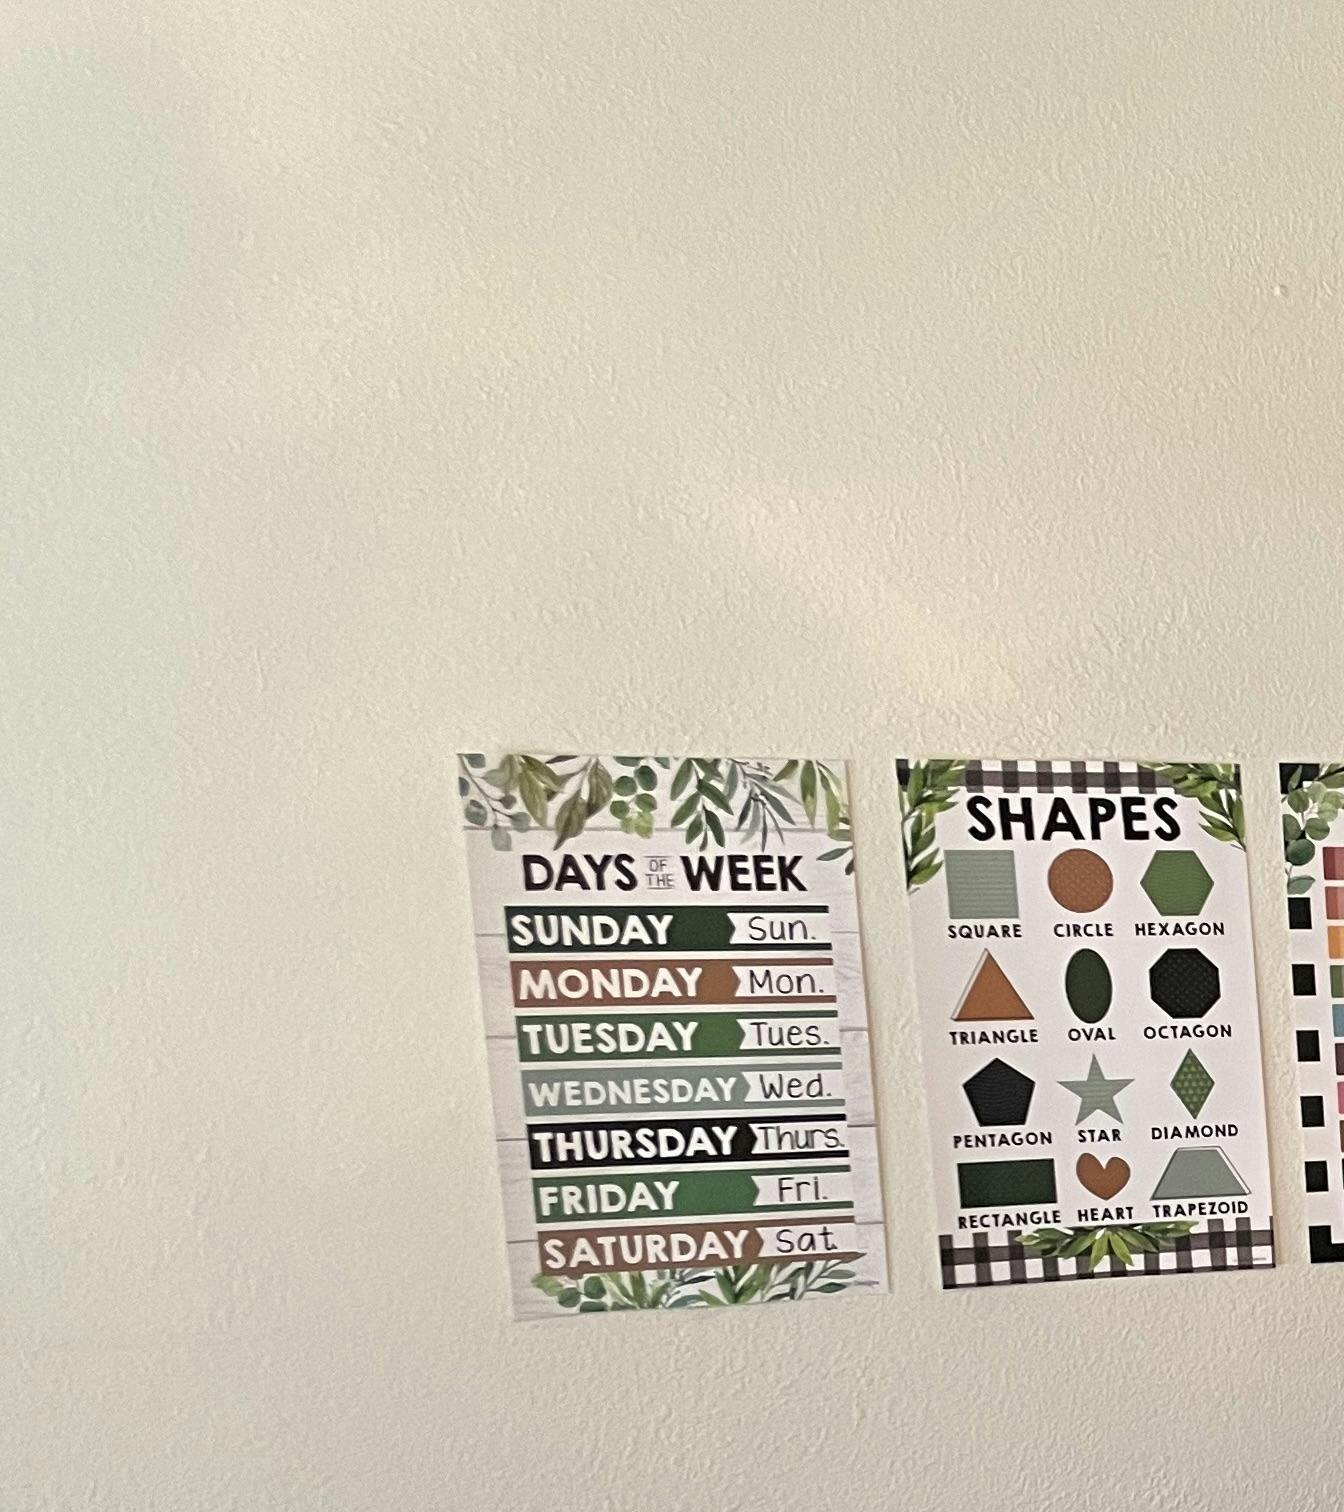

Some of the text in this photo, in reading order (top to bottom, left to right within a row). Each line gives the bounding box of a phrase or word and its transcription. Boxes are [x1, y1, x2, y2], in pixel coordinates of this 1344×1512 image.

[966, 795, 1181, 841] SHAPES
[522, 854, 808, 891] DAYS OF THE WEEK
[511, 915, 817, 945] SUNDAY Sun.
[948, 924, 1022, 939] SQUARE
[1054, 923, 1114, 938] CIRCLE
[1135, 922, 1225, 937] HEXAGON
[519, 967, 824, 1001] MONDAY Mon.
[523, 1022, 830, 1055] TUESDAY Tues.
[950, 1028, 1038, 1045] TRIANGLE
[1068, 1027, 1116, 1042] OVAL
[1143, 1024, 1232, 1040] OCTAGON
[529, 1073, 832, 1108] WEDNESDAY Wed.
[953, 1131, 1052, 1149] PENTAGON
[1078, 1128, 1121, 1143] STAR
[1151, 1124, 1238, 1140] DIAMOND
[534, 1126, 845, 1164] THURSDAY Thurs.
[539, 1178, 828, 1216] FRIDAY Fri.
[1078, 1206, 1134, 1222] HEART
[1152, 1199, 1248, 1218] TRAPEZOID
[958, 1209, 1061, 1230] RECTANGLE
[544, 1231, 749, 1269] SATURDAY
